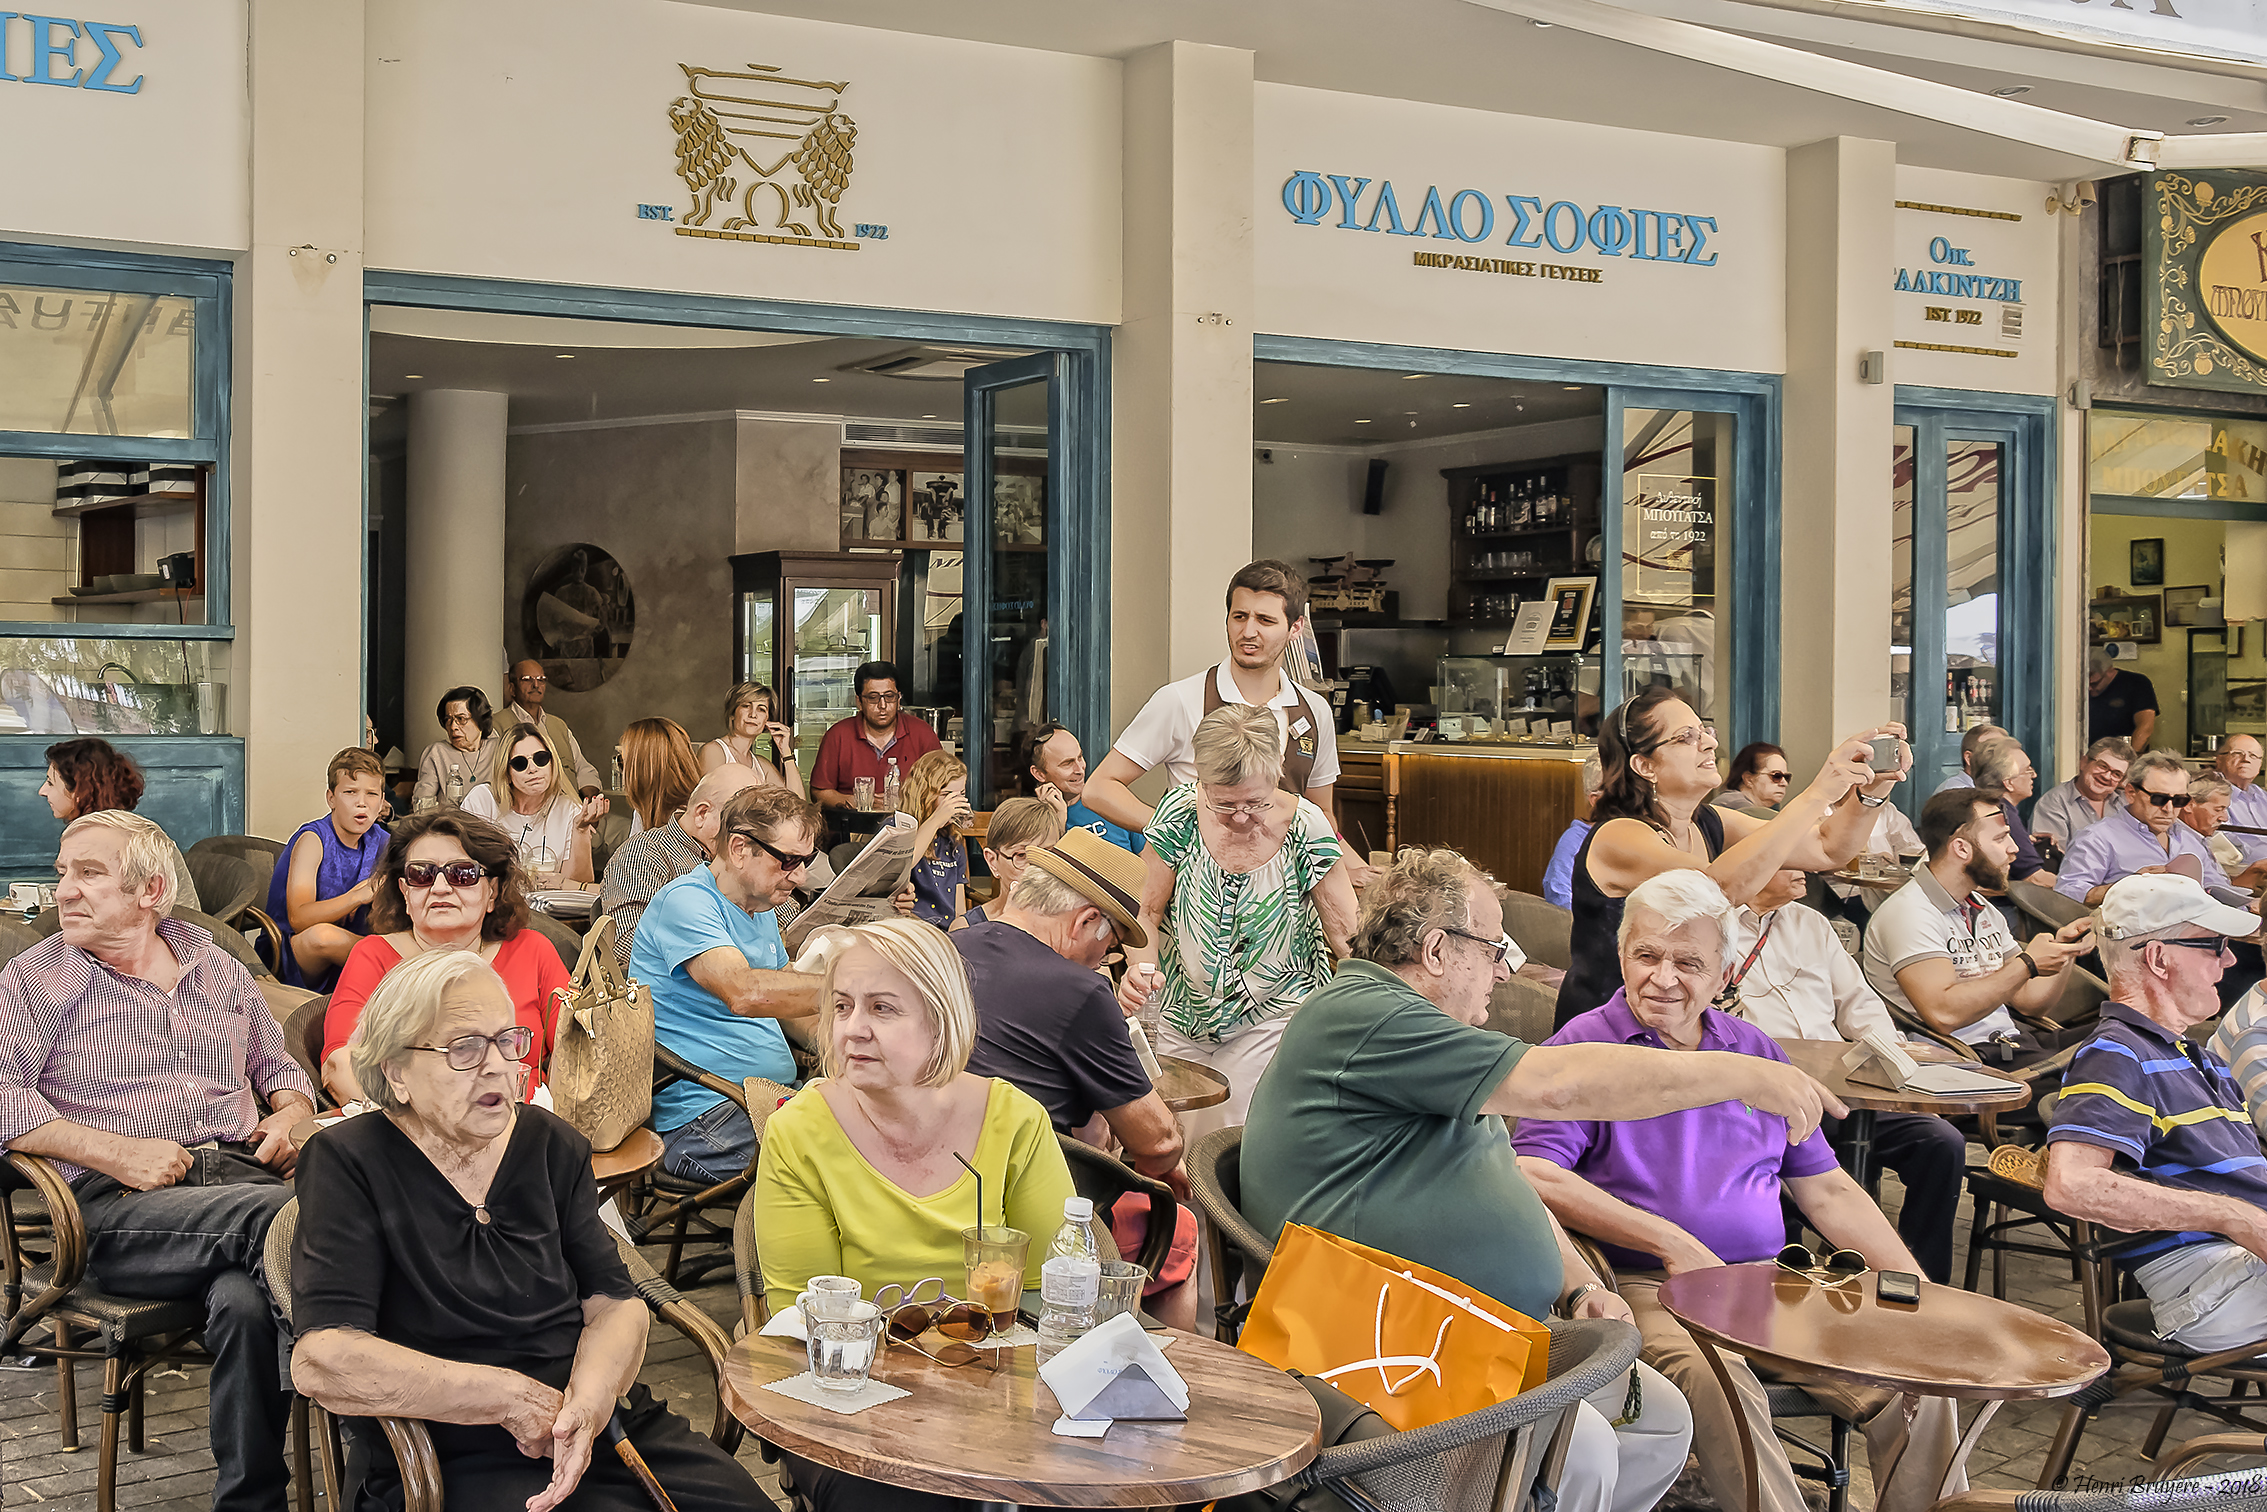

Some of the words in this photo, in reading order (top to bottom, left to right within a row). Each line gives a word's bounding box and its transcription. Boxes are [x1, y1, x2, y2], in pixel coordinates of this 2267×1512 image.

[637, 203, 676, 222] EST.
[1282, 170, 1495, 244] ΦΥΛΛΟ
[1505, 194, 1719, 267] ΣΟΦΙΕΣ
[855, 223, 889, 240] 1922
[1929, 236, 1975, 267] Οικ.
[1413, 250, 1537, 278] ΜΙΚΡΑΣΙΑΤΙΚΕΣ
[1540, 263, 1604, 285] ΓΕΥΣΕΙΣ
[1894, 267, 2023, 303] ΑΛΚΙΝΤΖΗ
[1955, 309, 1983, 326] 1922
[1683, 530, 1706, 542] 1922
